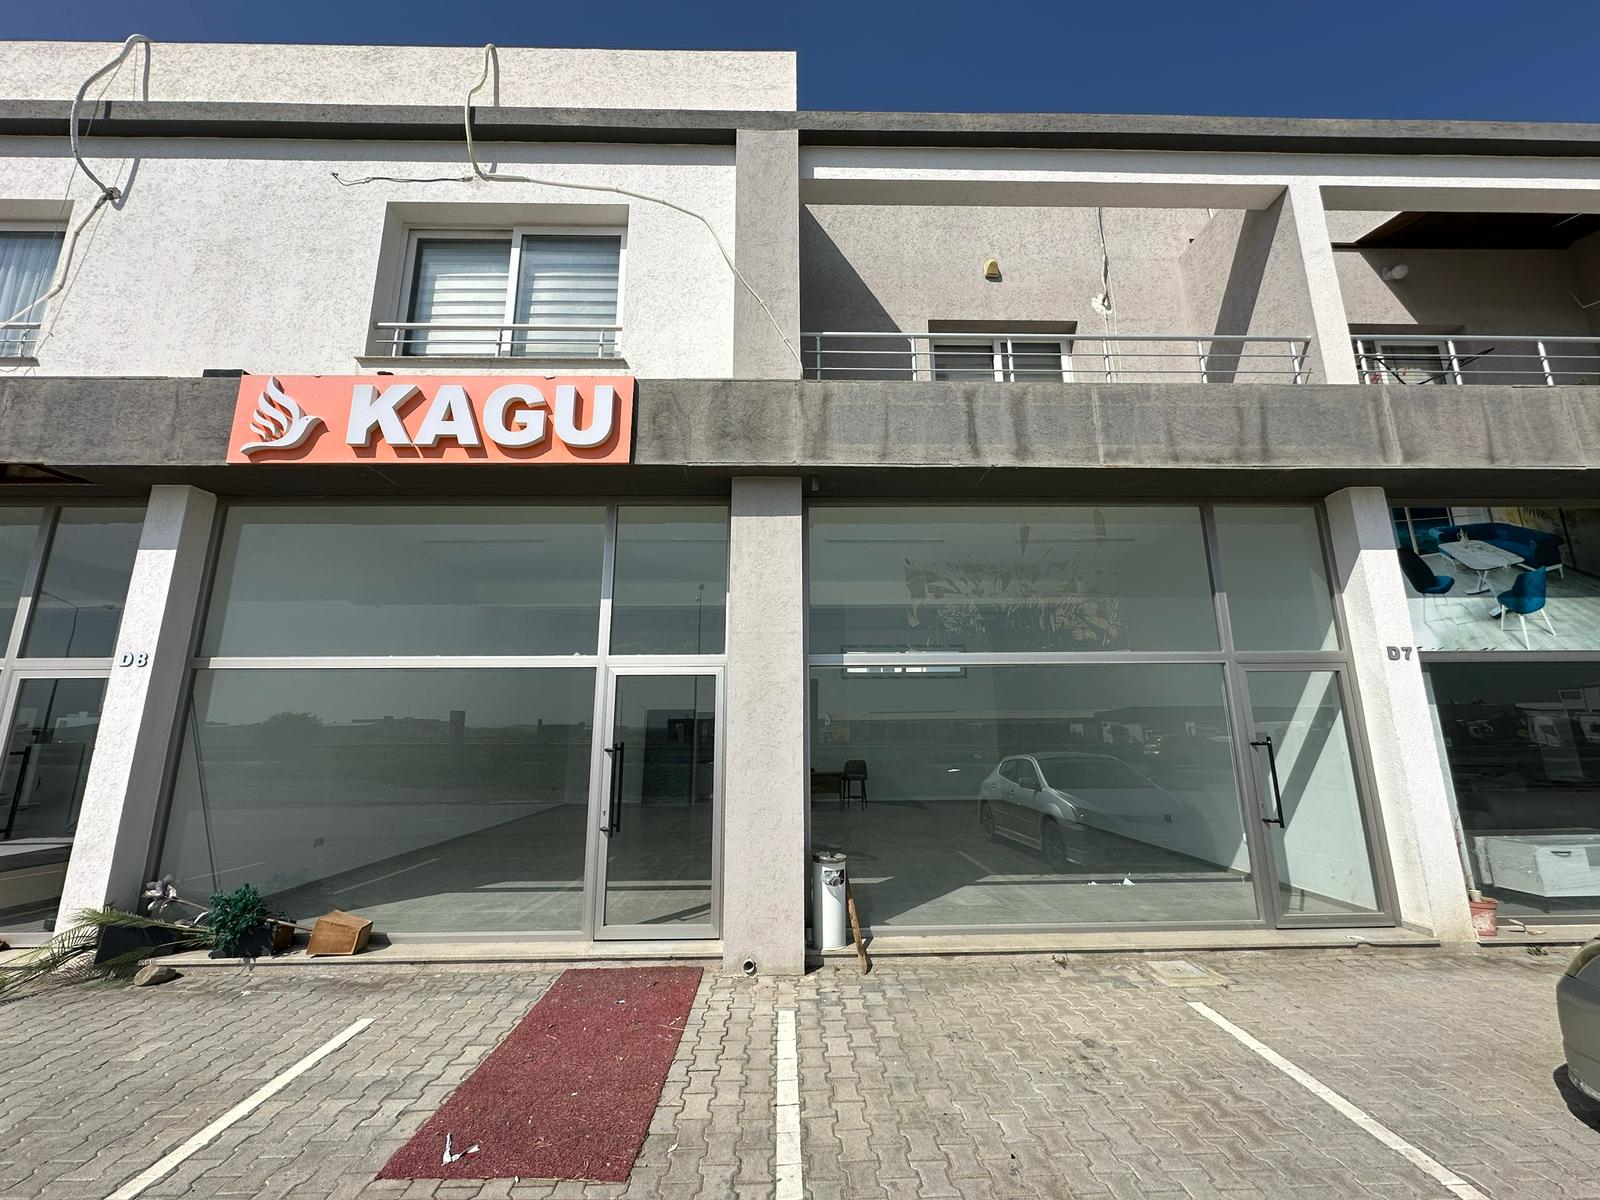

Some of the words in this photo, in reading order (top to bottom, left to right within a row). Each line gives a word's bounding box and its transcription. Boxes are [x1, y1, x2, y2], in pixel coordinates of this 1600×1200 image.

[346, 384, 614, 449] KAGU
[118, 651, 149, 668] D8
[1386, 645, 1412, 661] D7
